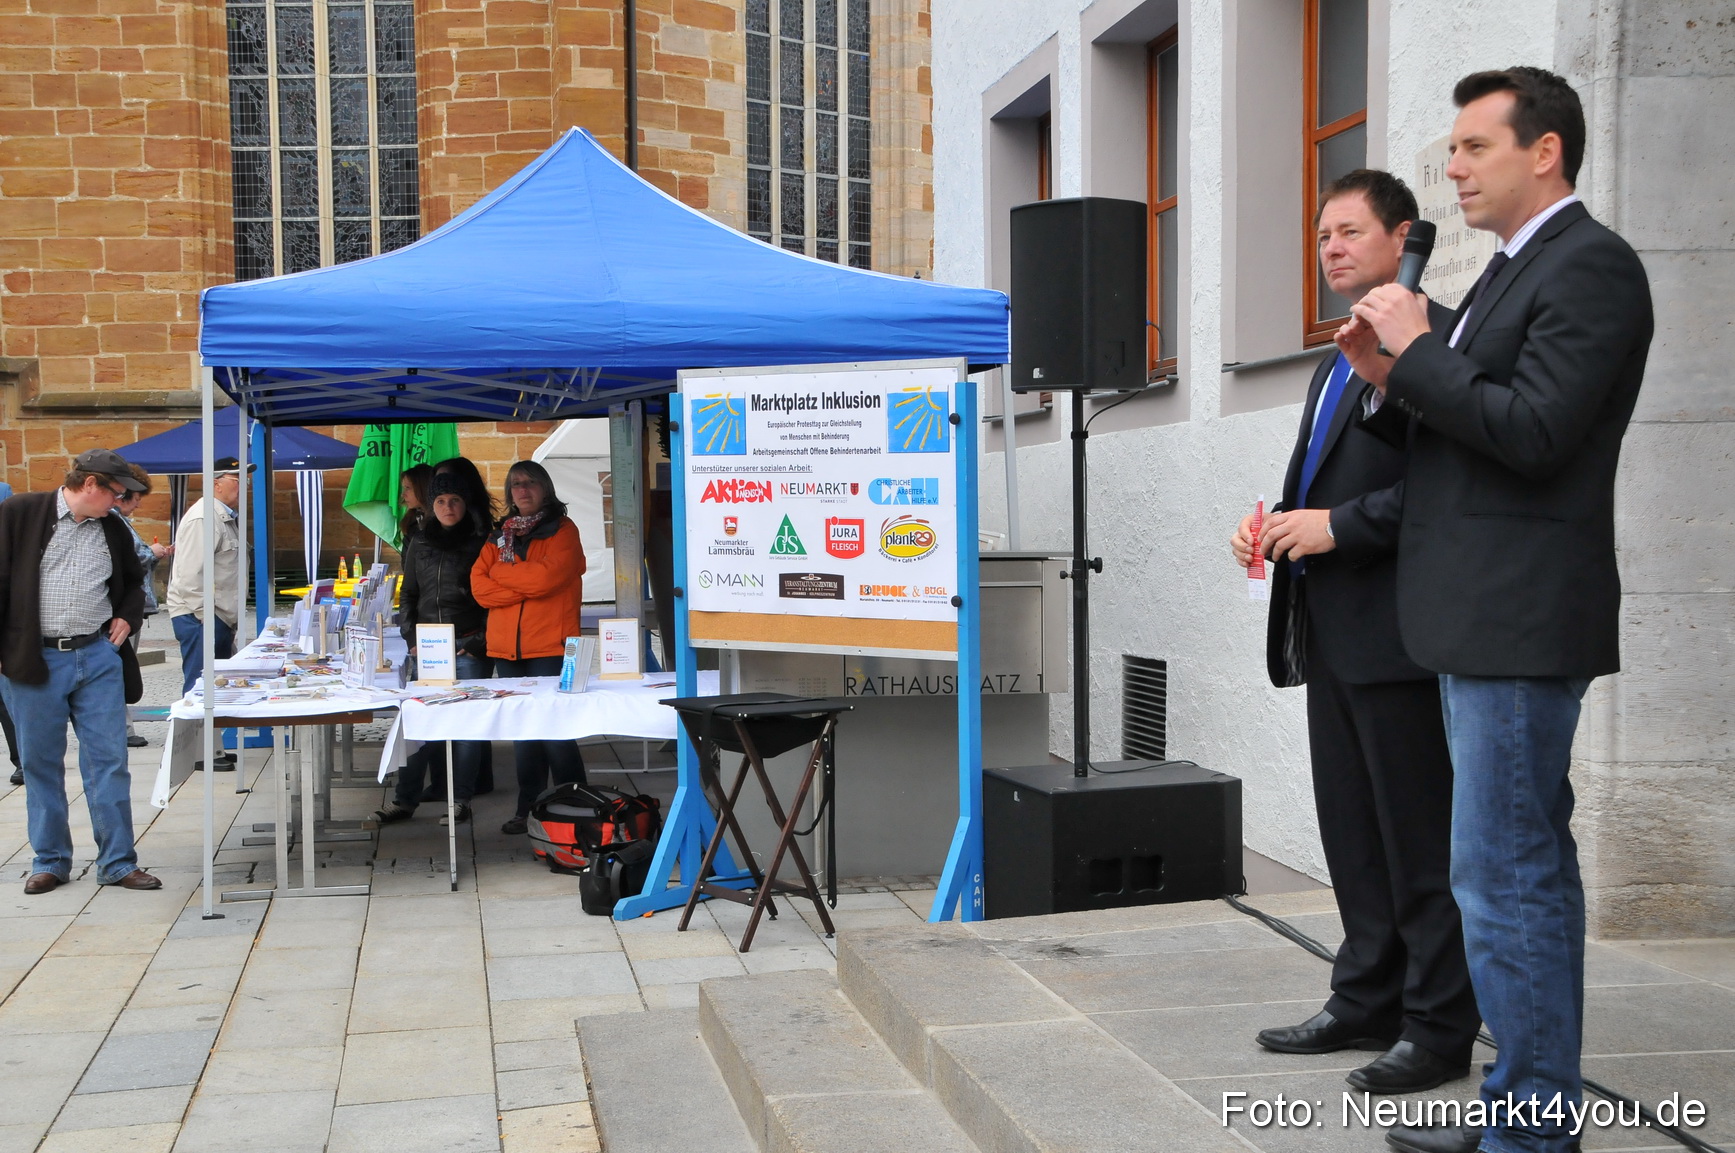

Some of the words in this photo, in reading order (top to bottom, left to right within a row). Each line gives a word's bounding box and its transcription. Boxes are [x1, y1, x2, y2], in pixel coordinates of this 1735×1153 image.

[751, 392, 818, 415] Marktplatz
[821, 390, 881, 410] Inklusion
[767, 420, 796, 430] Europäischer
[796, 420, 821, 429] Protesttag
[821, 420, 829, 428] zur
[829, 419, 862, 429] Gleichstellung
[788, 433, 812, 441] Menschen
[820, 432, 850, 441] Behinderung
[752, 447, 809, 457] Arbeitsgemeinschaft
[809, 446, 829, 456] Offene
[829, 446, 882, 455] Behindertenarbeit
[691, 464, 733, 473] Unterstützer
[760, 464, 787, 472] sozialen
[788, 463, 814, 472] Arbeit:
[876, 479, 911, 487] CHRISTLICHE
[780, 482, 848, 496] NEUMARKT
[831, 527, 858, 538] JURA
[714, 539, 749, 547] Neumarkter
[885, 531, 918, 549] plank
[708, 545, 755, 556] Lammsbräu
[831, 542, 859, 551] FLEISCH
[716, 573, 764, 588] MANN
[784, 580, 838, 589] VERANSTALTUNGSZENTRUM
[859, 584, 907, 597] DRUCK
[912, 585, 920, 597] &
[846, 673, 1021, 696] RATHAUSATZ
